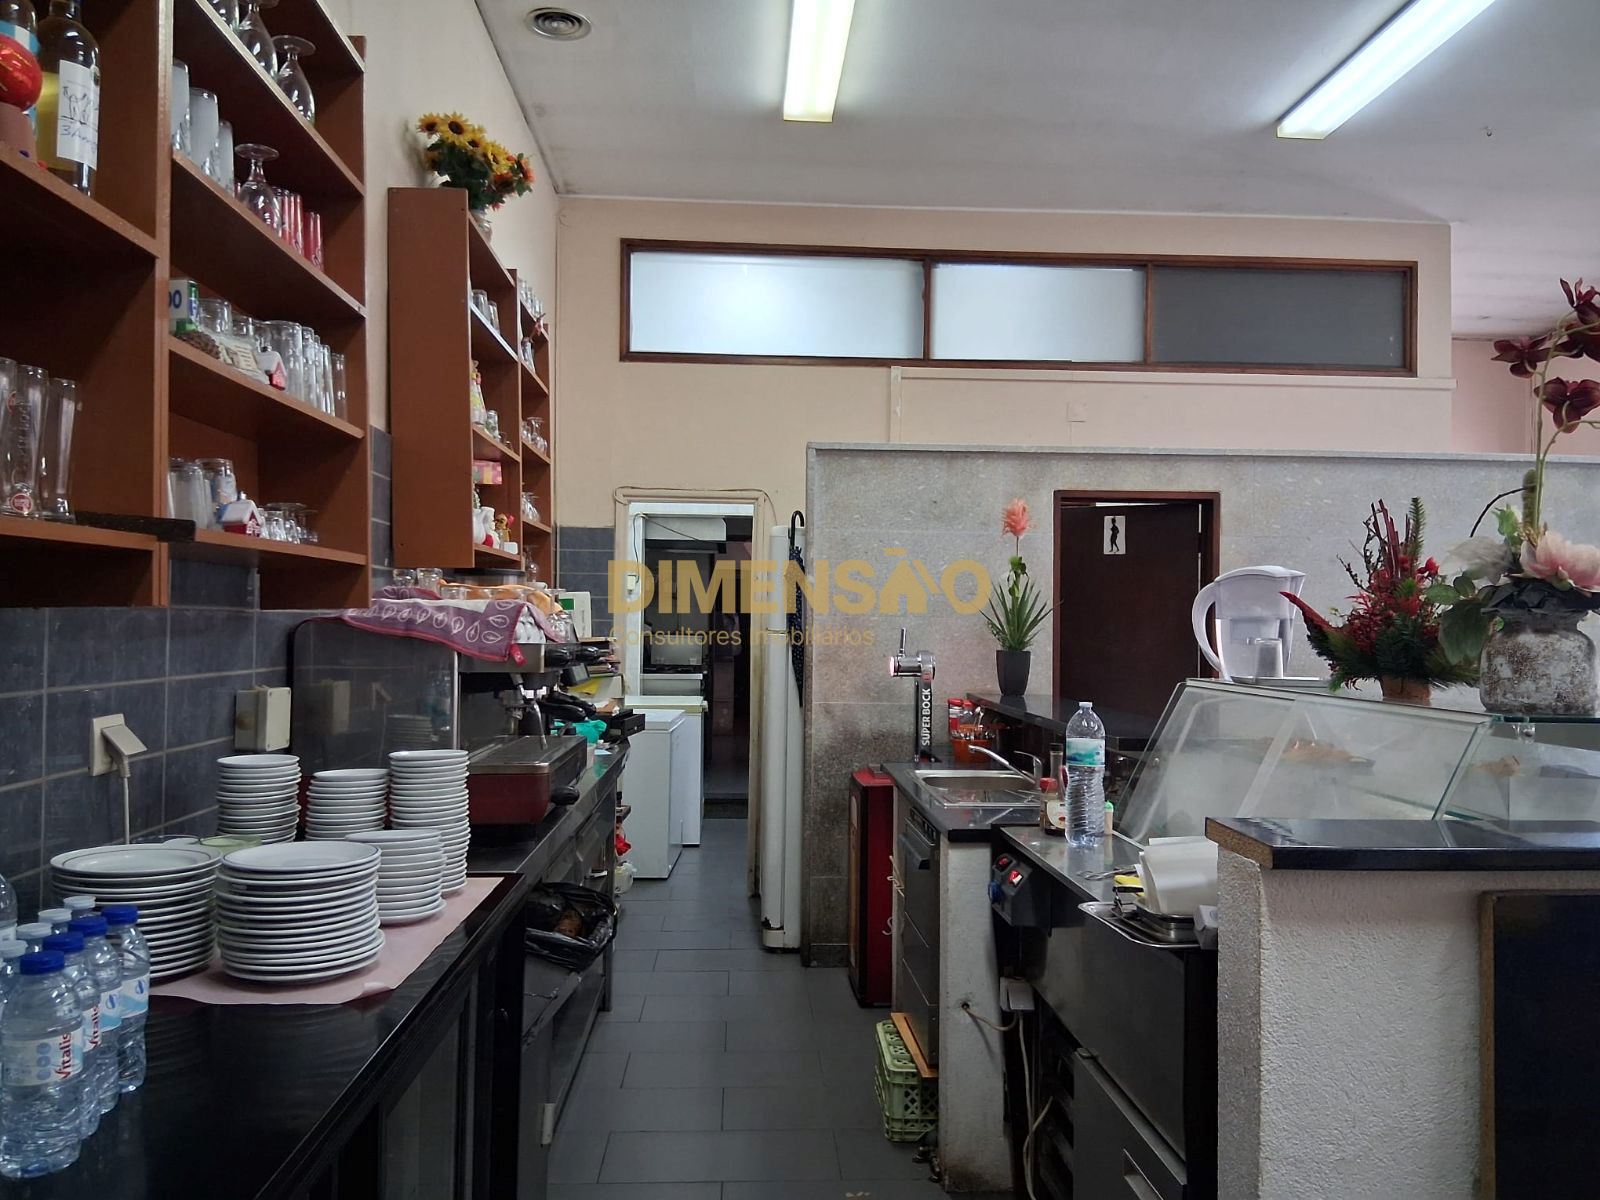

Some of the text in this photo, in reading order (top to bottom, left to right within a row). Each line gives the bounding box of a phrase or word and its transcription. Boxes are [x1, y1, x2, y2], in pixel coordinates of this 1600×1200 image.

[922, 688, 931, 746] SUPER BOCK
[55, 1033, 72, 1079] Vitalis
